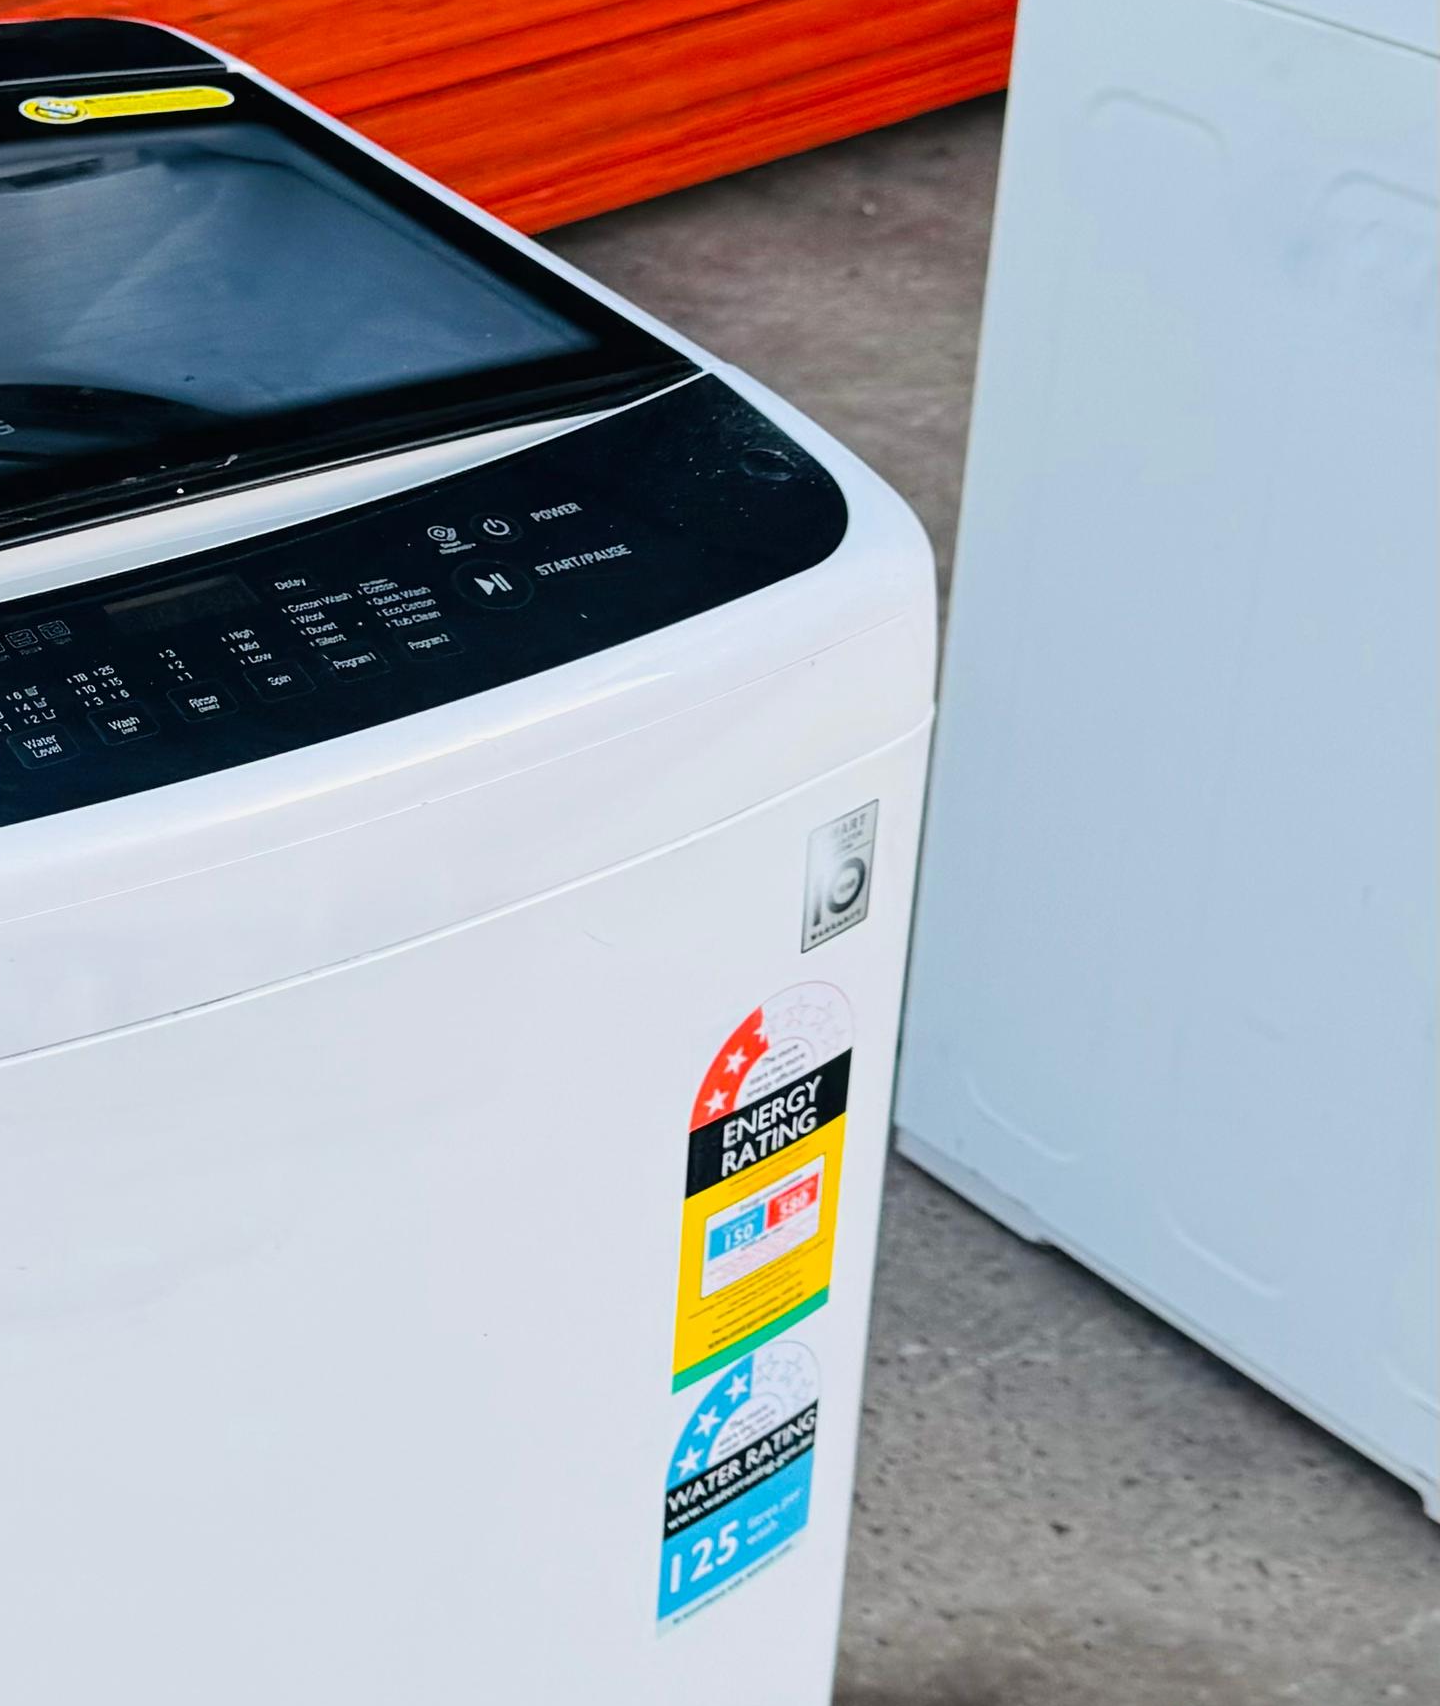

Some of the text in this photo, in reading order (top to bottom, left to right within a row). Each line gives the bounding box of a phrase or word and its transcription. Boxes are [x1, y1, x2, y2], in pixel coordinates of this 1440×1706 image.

[530, 502, 583, 522] POWER
[534, 543, 633, 577] START/PAUSE
[274, 578, 306, 590] Delay
[381, 606, 403, 617] Eco
[390, 616, 413, 627] Tub
[228, 628, 255, 641] High
[165, 648, 177, 658] 3
[247, 653, 272, 664] Low
[98, 664, 115, 676] 25
[174, 660, 185, 669] 2
[81, 676, 123, 695] 10 15
[267, 674, 292, 686] Spin
[12, 691, 23, 700] 6
[92, 689, 130, 706] 3 6
[22, 702, 32, 711] 4
[29, 714, 41, 724] 2
[107, 715, 141, 731] Wash
[22, 734, 57, 750] Water
[32, 743, 63, 759] Level
[722, 1075, 822, 1149] ENERGY
[721, 1107, 817, 1177] RATING
[724, 1223, 755, 1253] 150
[667, 1458, 743, 1512] WATER
[745, 1408, 817, 1470] RATING
[669, 1519, 740, 1594] 125
